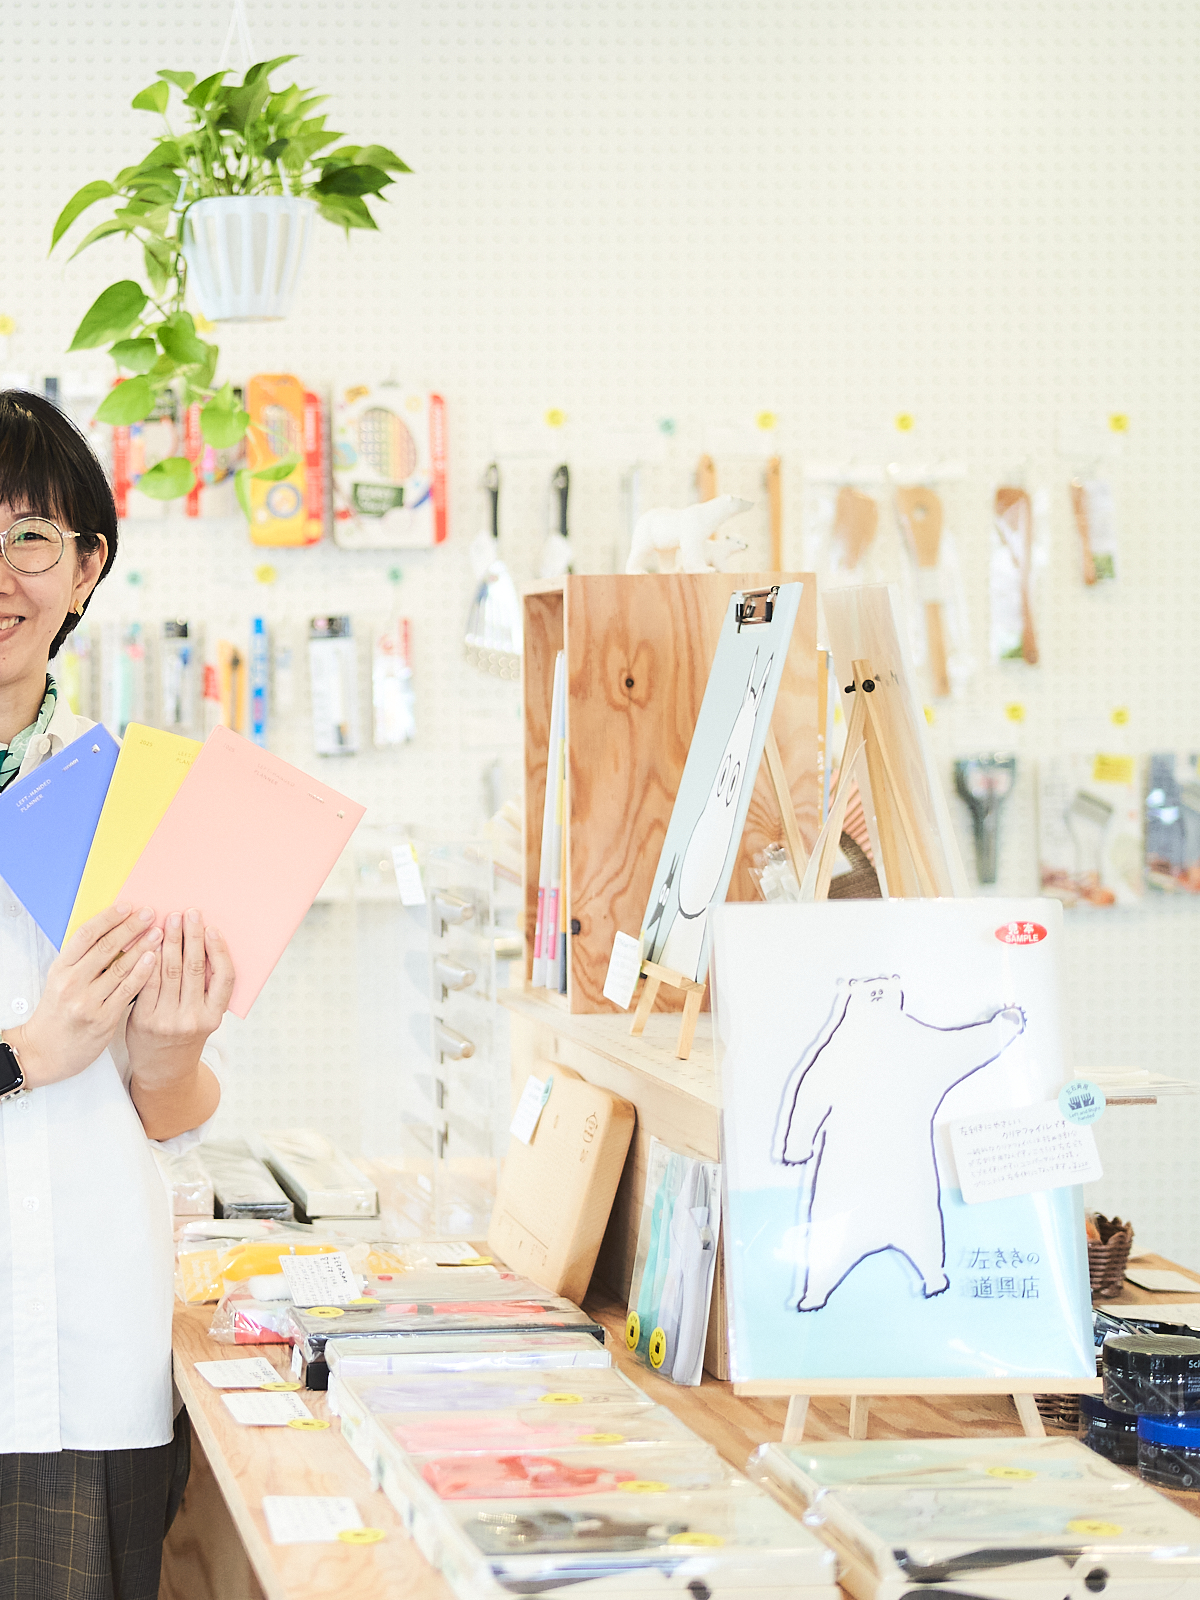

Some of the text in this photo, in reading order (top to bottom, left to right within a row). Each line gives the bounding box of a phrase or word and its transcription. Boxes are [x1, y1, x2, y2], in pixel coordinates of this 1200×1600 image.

[16, 779, 52, 808] LEFT-HANDED
[20, 794, 44, 813] PLANNER
[1004, 933, 1040, 943] SAMPLE
[1008, 922, 1035, 936] 見本
[971, 1247, 1040, 1270] 左ききの
[972, 1275, 1040, 1299] 道具店
